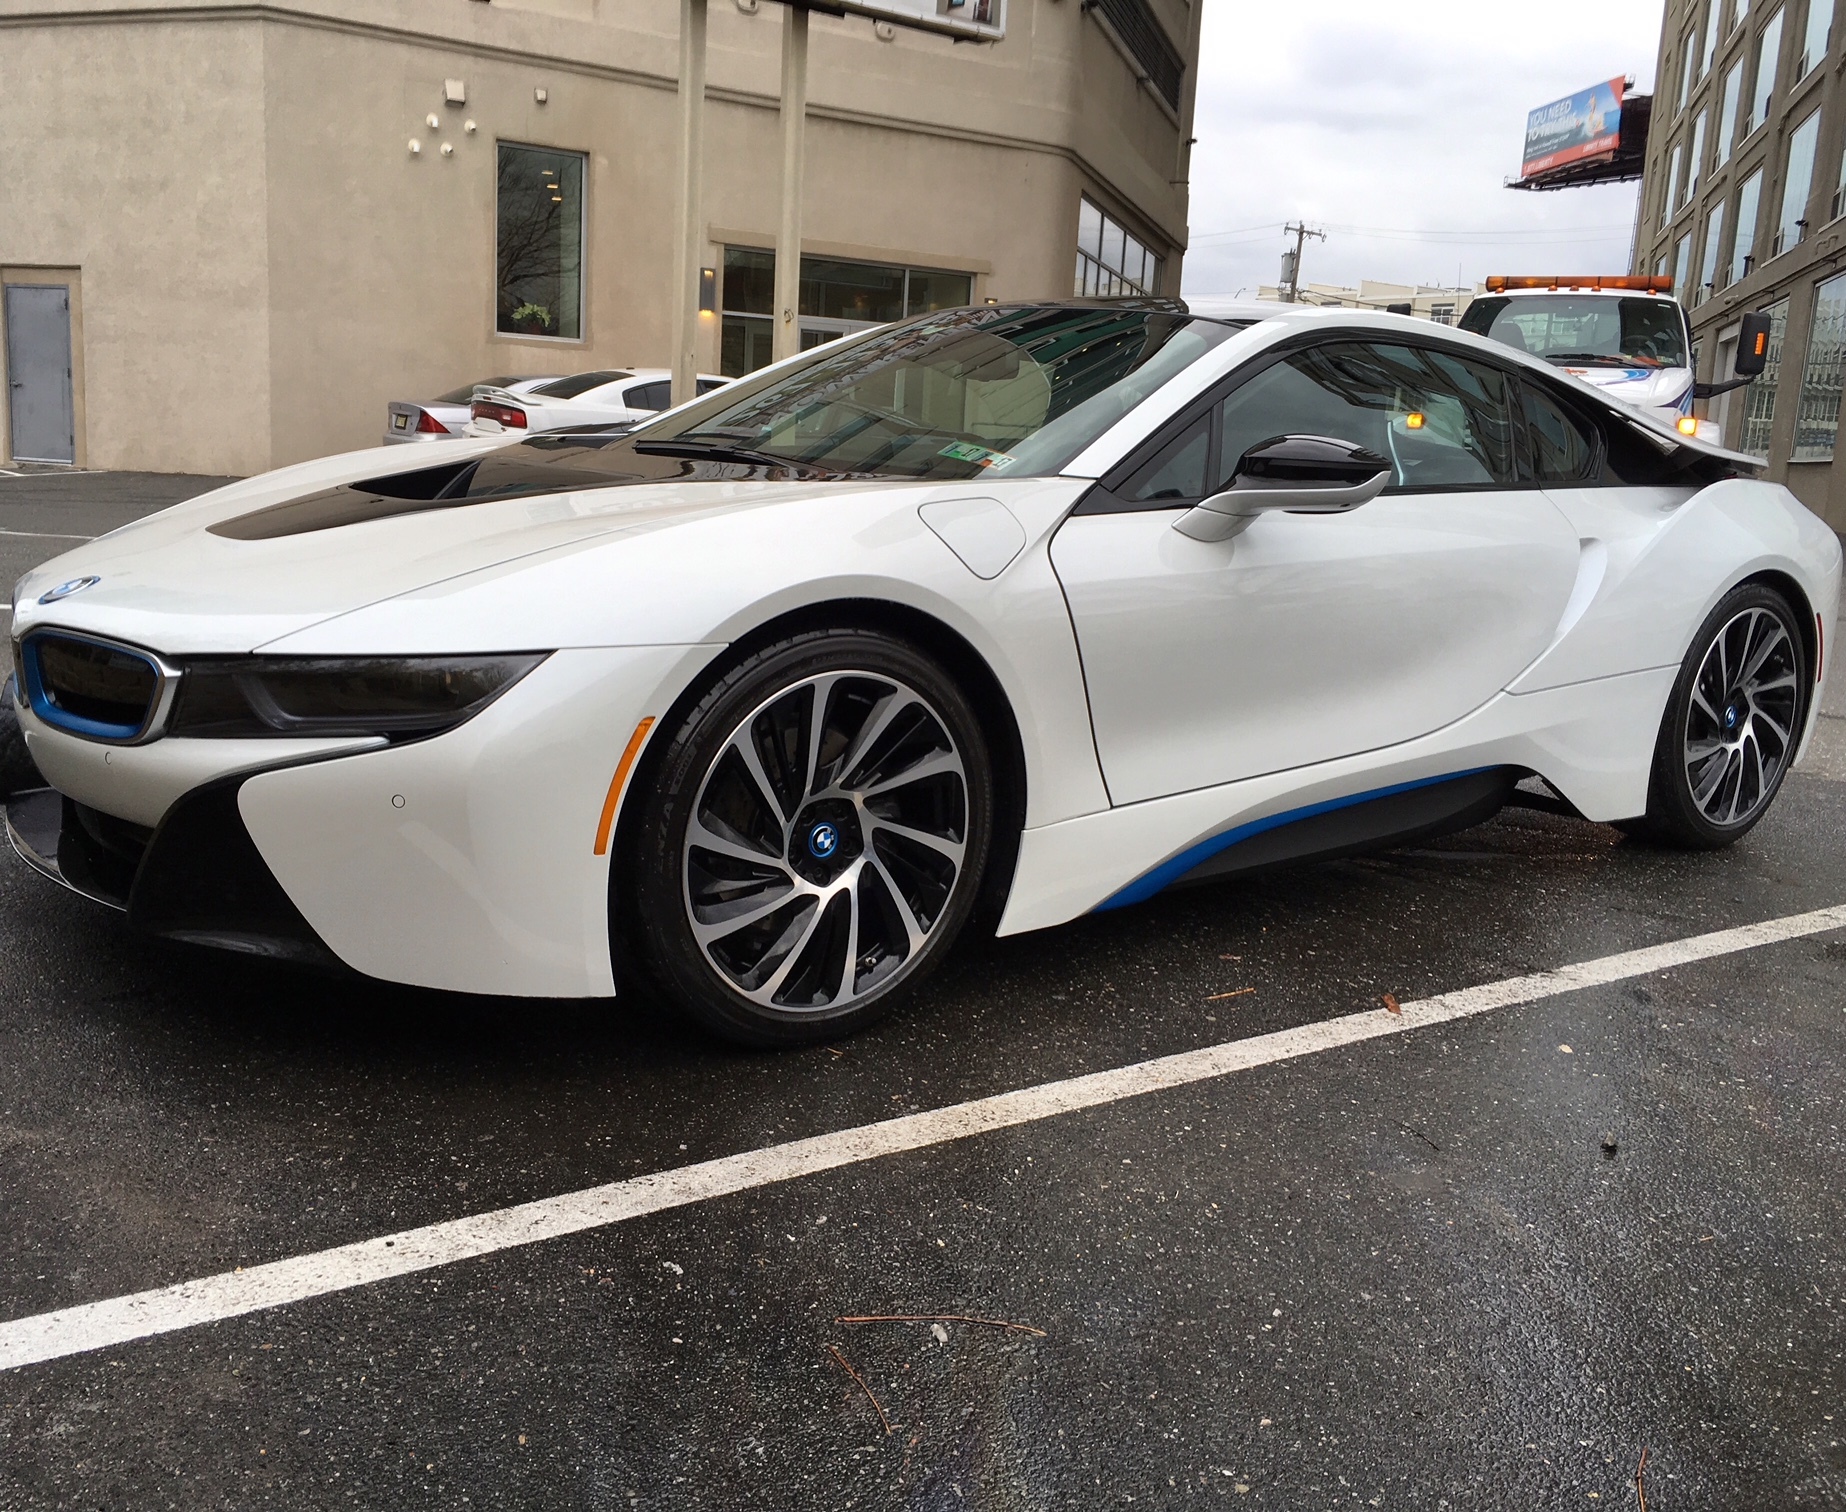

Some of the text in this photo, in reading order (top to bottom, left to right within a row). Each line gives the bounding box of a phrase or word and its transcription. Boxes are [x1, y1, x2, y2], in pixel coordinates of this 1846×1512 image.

[1529, 99, 1571, 126] YOU NEED
[1527, 127, 1539, 142] TO
